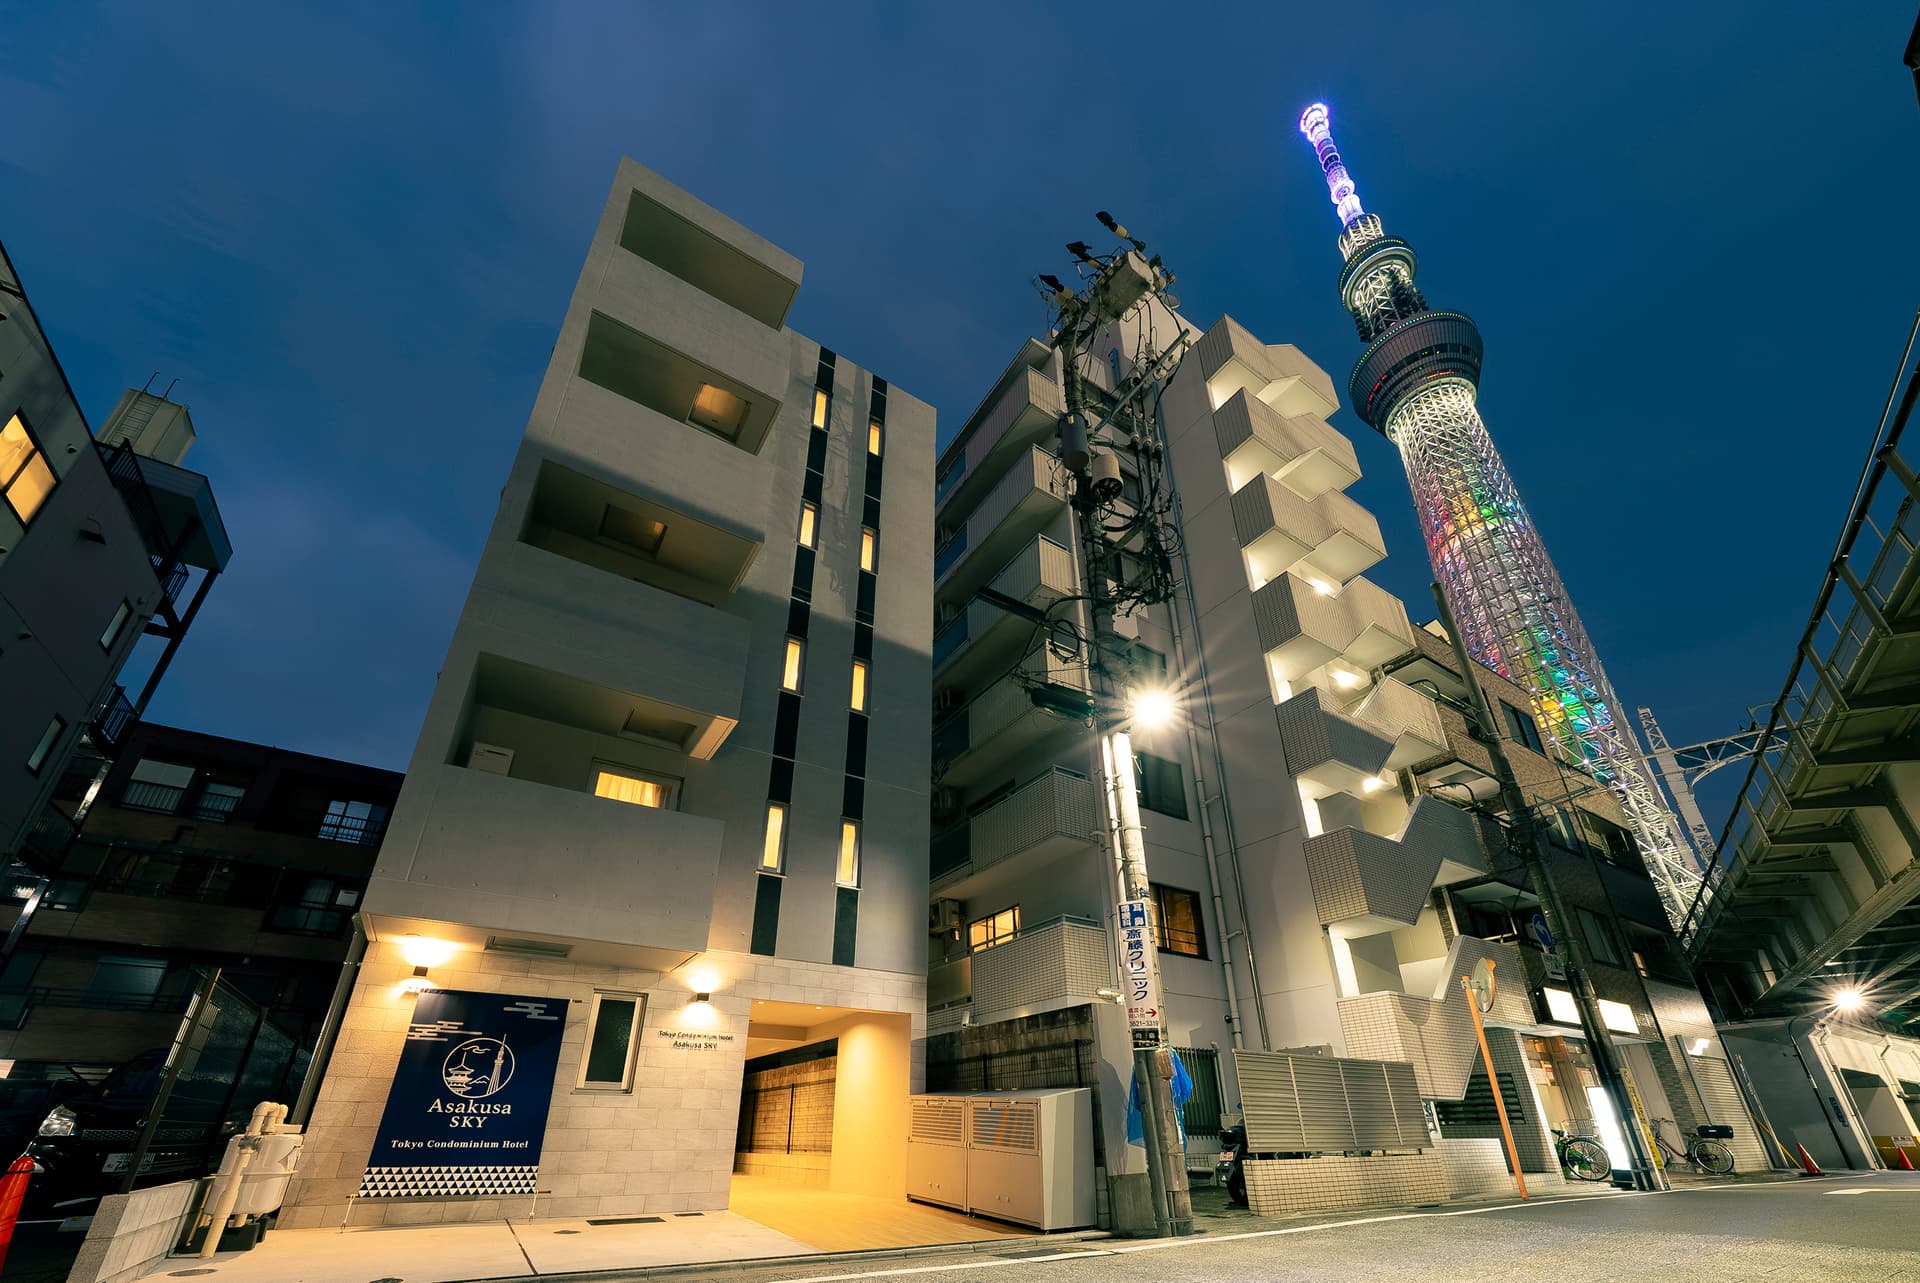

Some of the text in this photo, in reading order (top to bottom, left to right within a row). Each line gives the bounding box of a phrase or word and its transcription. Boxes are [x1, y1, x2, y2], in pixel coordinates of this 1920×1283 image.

[659, 1030, 676, 1038] Tokyo
[673, 1041, 702, 1049] Asakusa
[427, 1098, 511, 1114] Asakusa
[449, 1116, 487, 1128] SKY
[391, 1140, 529, 1150] Tokyo Condominium Hotel
